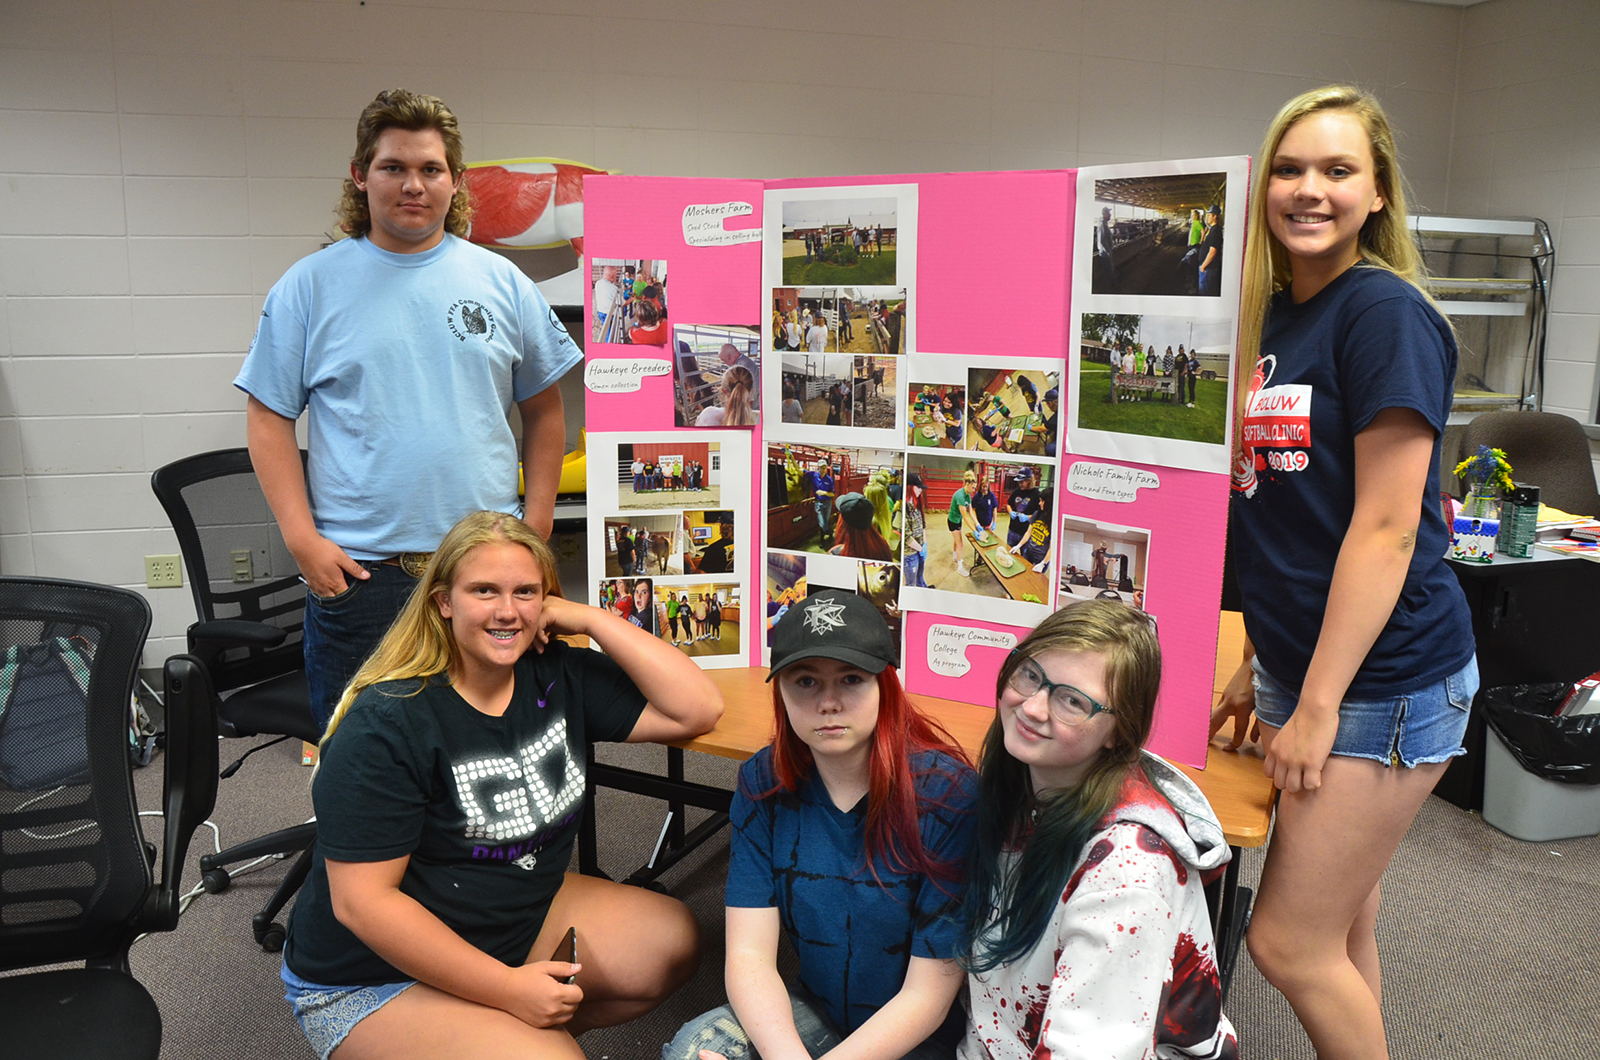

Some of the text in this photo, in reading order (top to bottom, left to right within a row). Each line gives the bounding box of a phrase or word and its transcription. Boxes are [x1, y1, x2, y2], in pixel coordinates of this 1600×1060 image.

[685, 202, 753, 217] Moshers Farm
[702, 221, 720, 231] Stock
[448, 303, 459, 316] FFA
[458, 299, 495, 323] Community
[446, 316, 466, 342] BCLUW
[589, 362, 671, 377] Hawkeye Breeders
[590, 381, 639, 390] Semen collection
[1244, 424, 1304, 441] SOFTBALL CLINIC
[1268, 450, 1309, 472] 2019
[1072, 464, 1104, 478] Nichols
[1105, 468, 1134, 484] Family
[1117, 489, 1134, 500] types
[932, 627, 1011, 647] Hawkeye Community
[933, 643, 959, 656] College
[932, 658, 967, 669] Ag program
